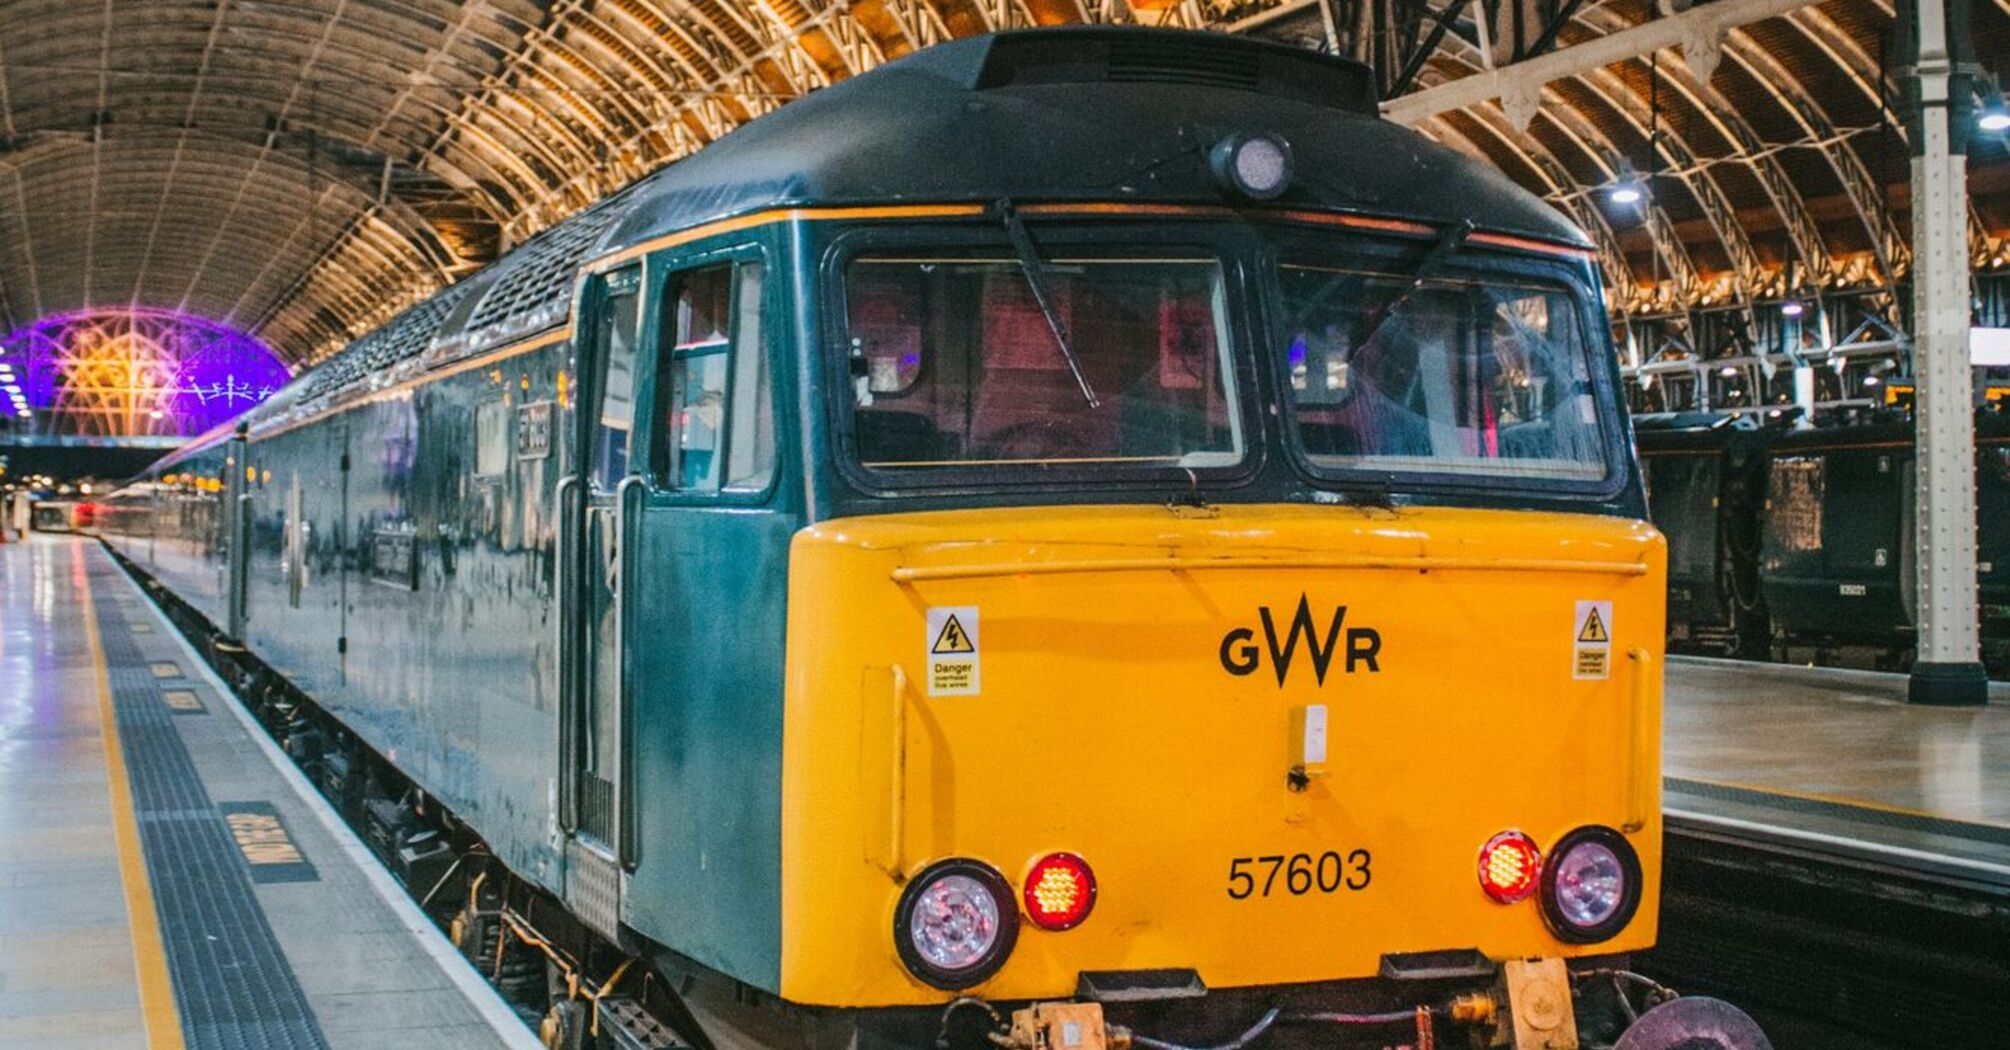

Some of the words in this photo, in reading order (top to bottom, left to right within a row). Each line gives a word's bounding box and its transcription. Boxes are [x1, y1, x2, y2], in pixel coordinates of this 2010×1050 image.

[1219, 591, 1381, 689] GWR
[935, 663, 972, 674] Danger
[1227, 848, 1371, 900] 57603
